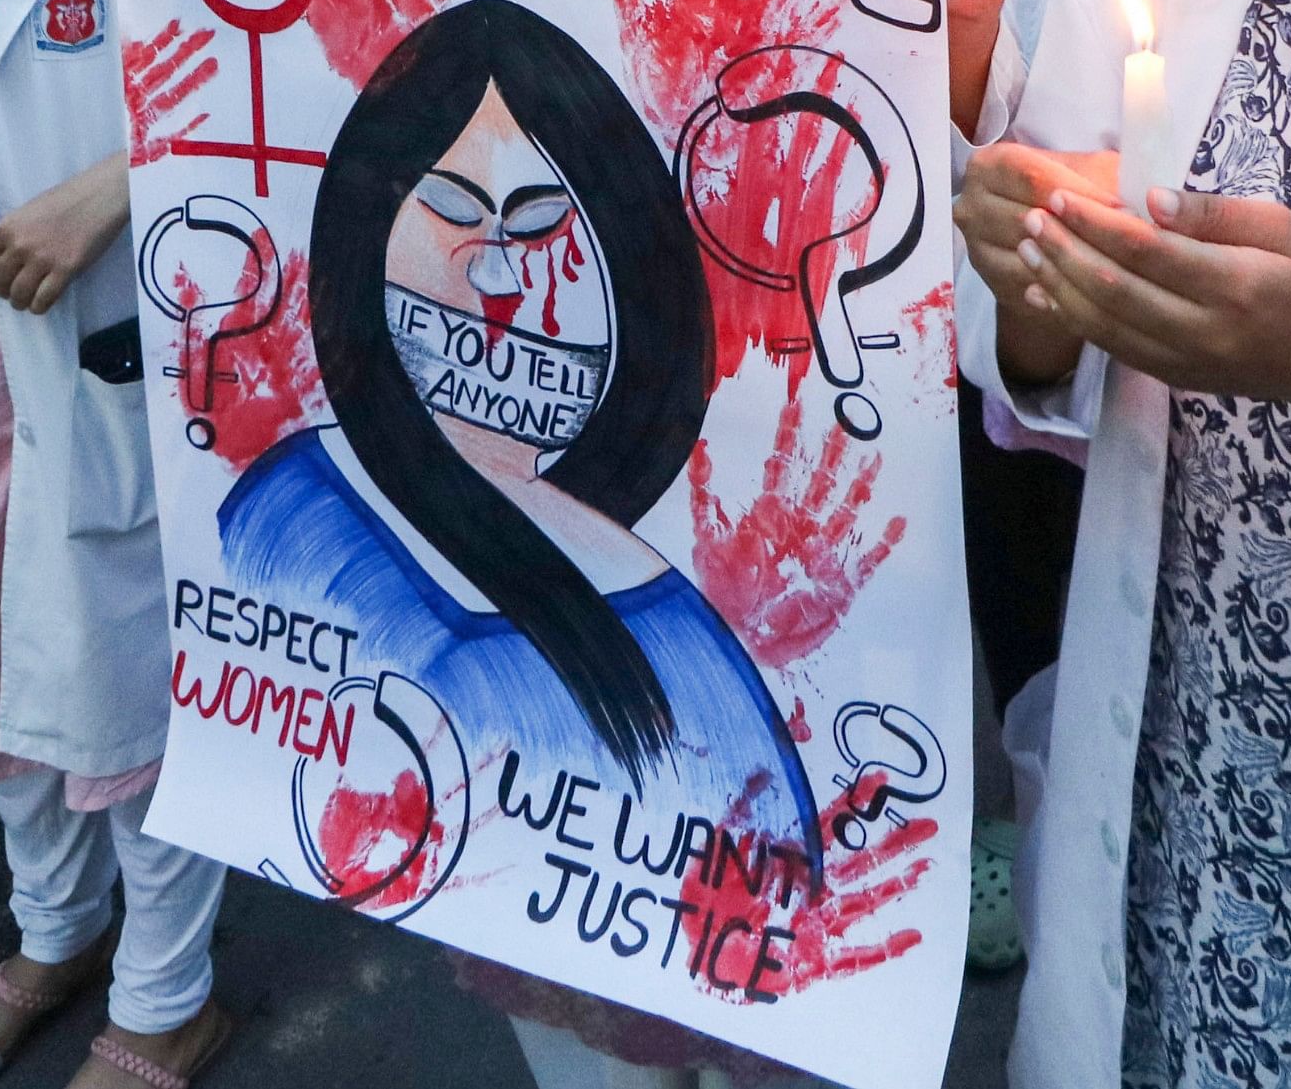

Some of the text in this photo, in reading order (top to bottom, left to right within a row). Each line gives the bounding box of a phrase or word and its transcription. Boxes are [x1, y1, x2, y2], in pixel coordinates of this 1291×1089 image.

[399, 300, 595, 400] IF YOU TELL
[425, 369, 578, 440] ANYONE
[174, 579, 359, 677] RESPECT
[170, 651, 356, 767] WOMEN
[499, 750, 814, 909] WE WANT
[527, 852, 797, 1004] JUSTICE
